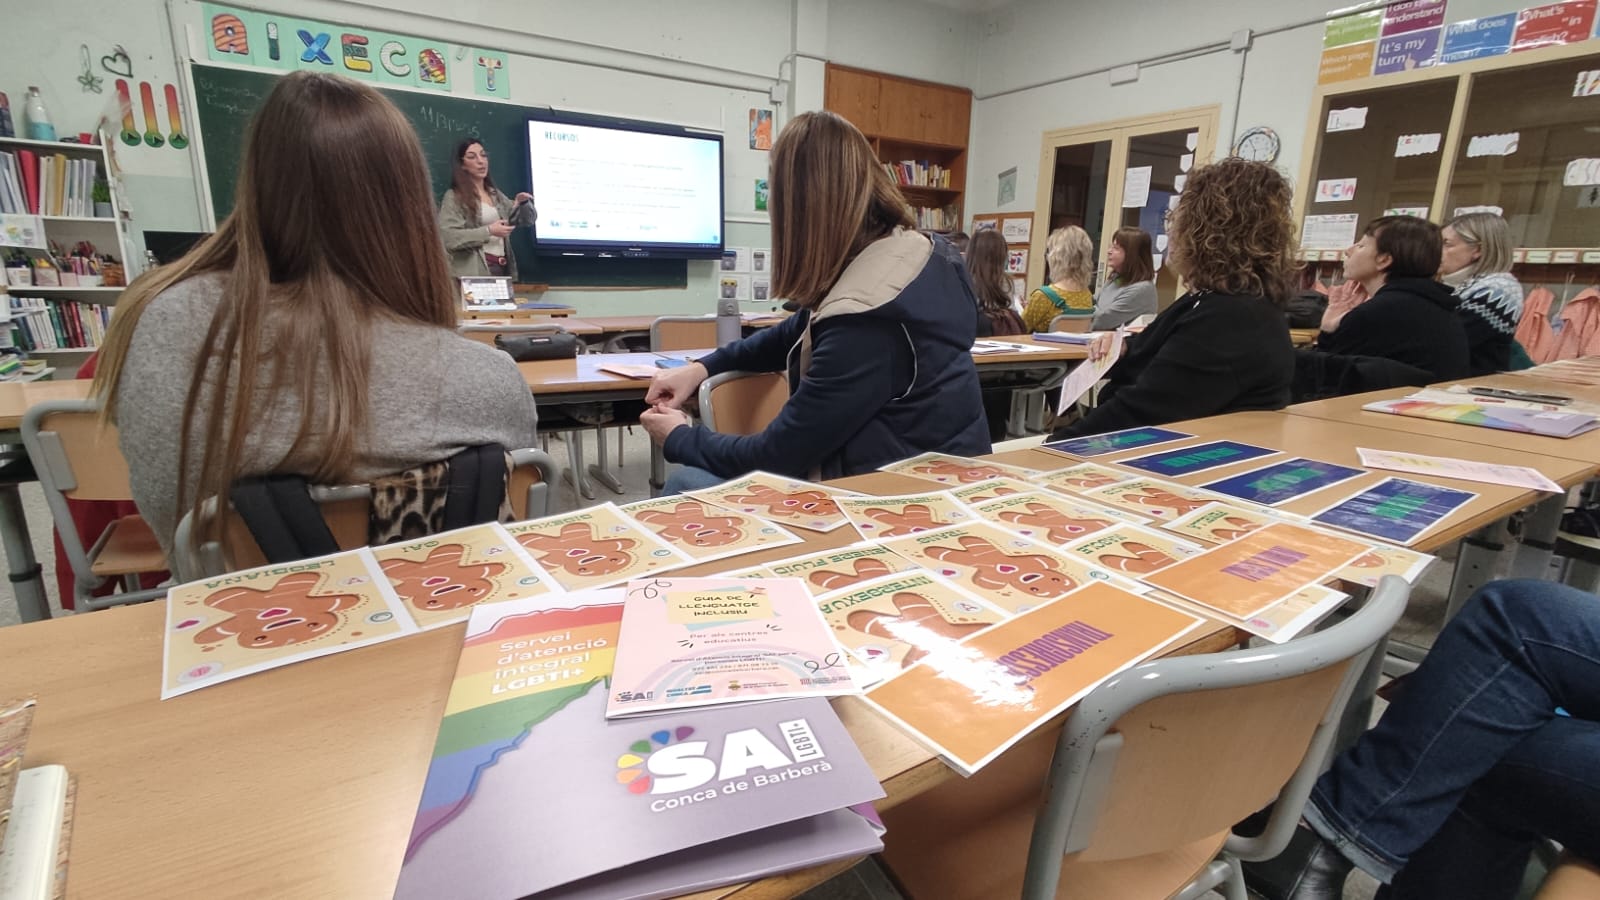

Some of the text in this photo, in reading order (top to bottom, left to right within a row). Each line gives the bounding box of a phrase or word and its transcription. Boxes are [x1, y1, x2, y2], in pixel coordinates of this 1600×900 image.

[1479, 18, 1507, 29] does
[1381, 38, 1430, 54] It's my
[545, 130, 579, 143] RECURSOS
[403, 540, 440, 552] GAI
[820, 575, 934, 613] INTERSEXUA
[497, 638, 607, 665] d'atenció
[500, 631, 571, 652] Servei
[495, 652, 590, 679] integral
[492, 668, 585, 694] LGBTI+
[787, 722, 817, 758] LGBTI+
[647, 718, 825, 795] SAI
[650, 761, 832, 812] Conca de Barberà
